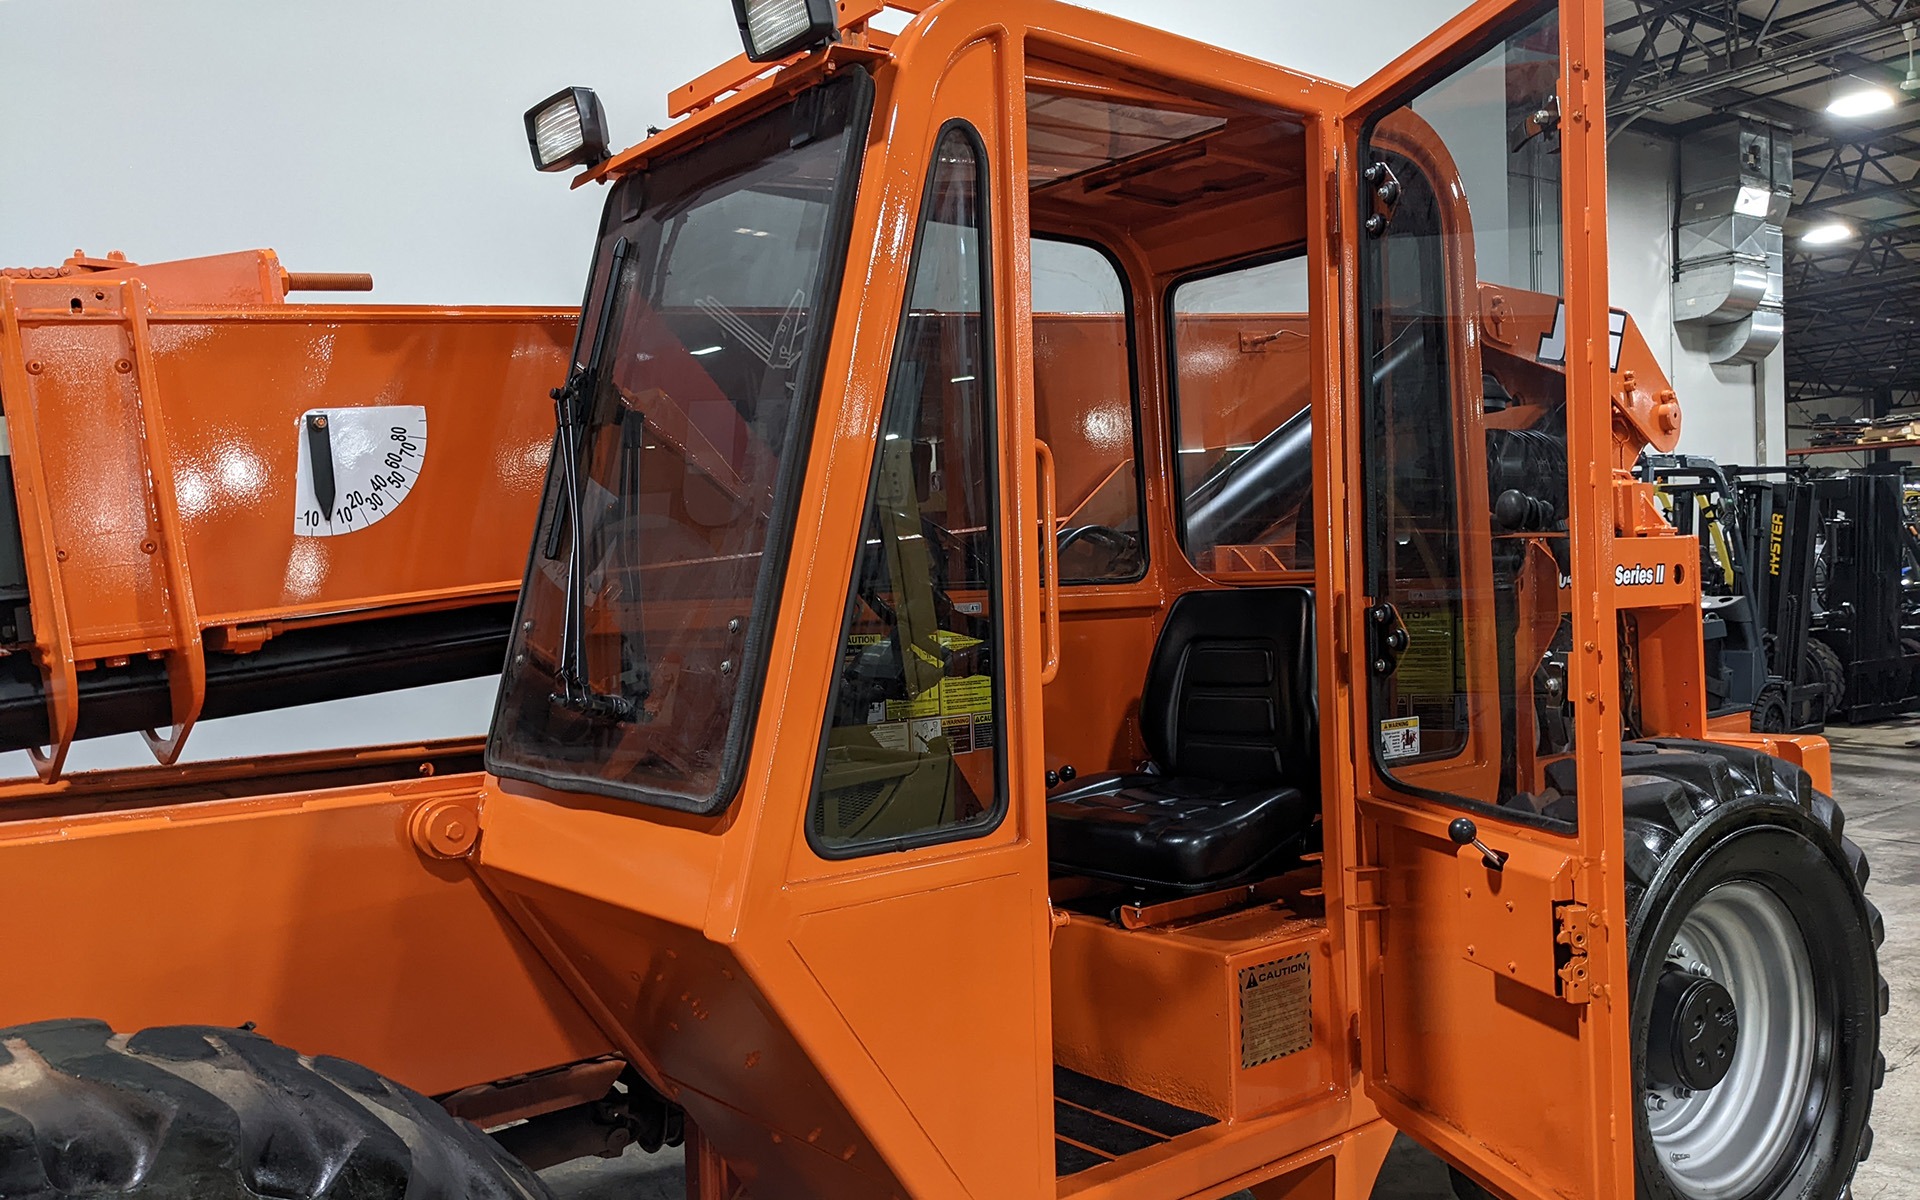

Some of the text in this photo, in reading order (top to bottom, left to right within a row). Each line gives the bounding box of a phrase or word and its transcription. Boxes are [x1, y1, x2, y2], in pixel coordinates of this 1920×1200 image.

[390, 426, 407, 442] 80
[399, 442, 417, 458] 70
[384, 452, 402, 469] 60
[370, 474, 388, 491] 40
[386, 470, 405, 488] 50
[346, 490, 364, 509] 20
[365, 492, 384, 511] 30
[336, 506, 353, 524] 10
[1769, 512, 1784, 576] HYSTER
[1614, 563, 1666, 585] Series II
[847, 635, 875, 644] AUTION
[946, 717, 969, 725] WARNING
[1258, 962, 1306, 982] CAUTION
